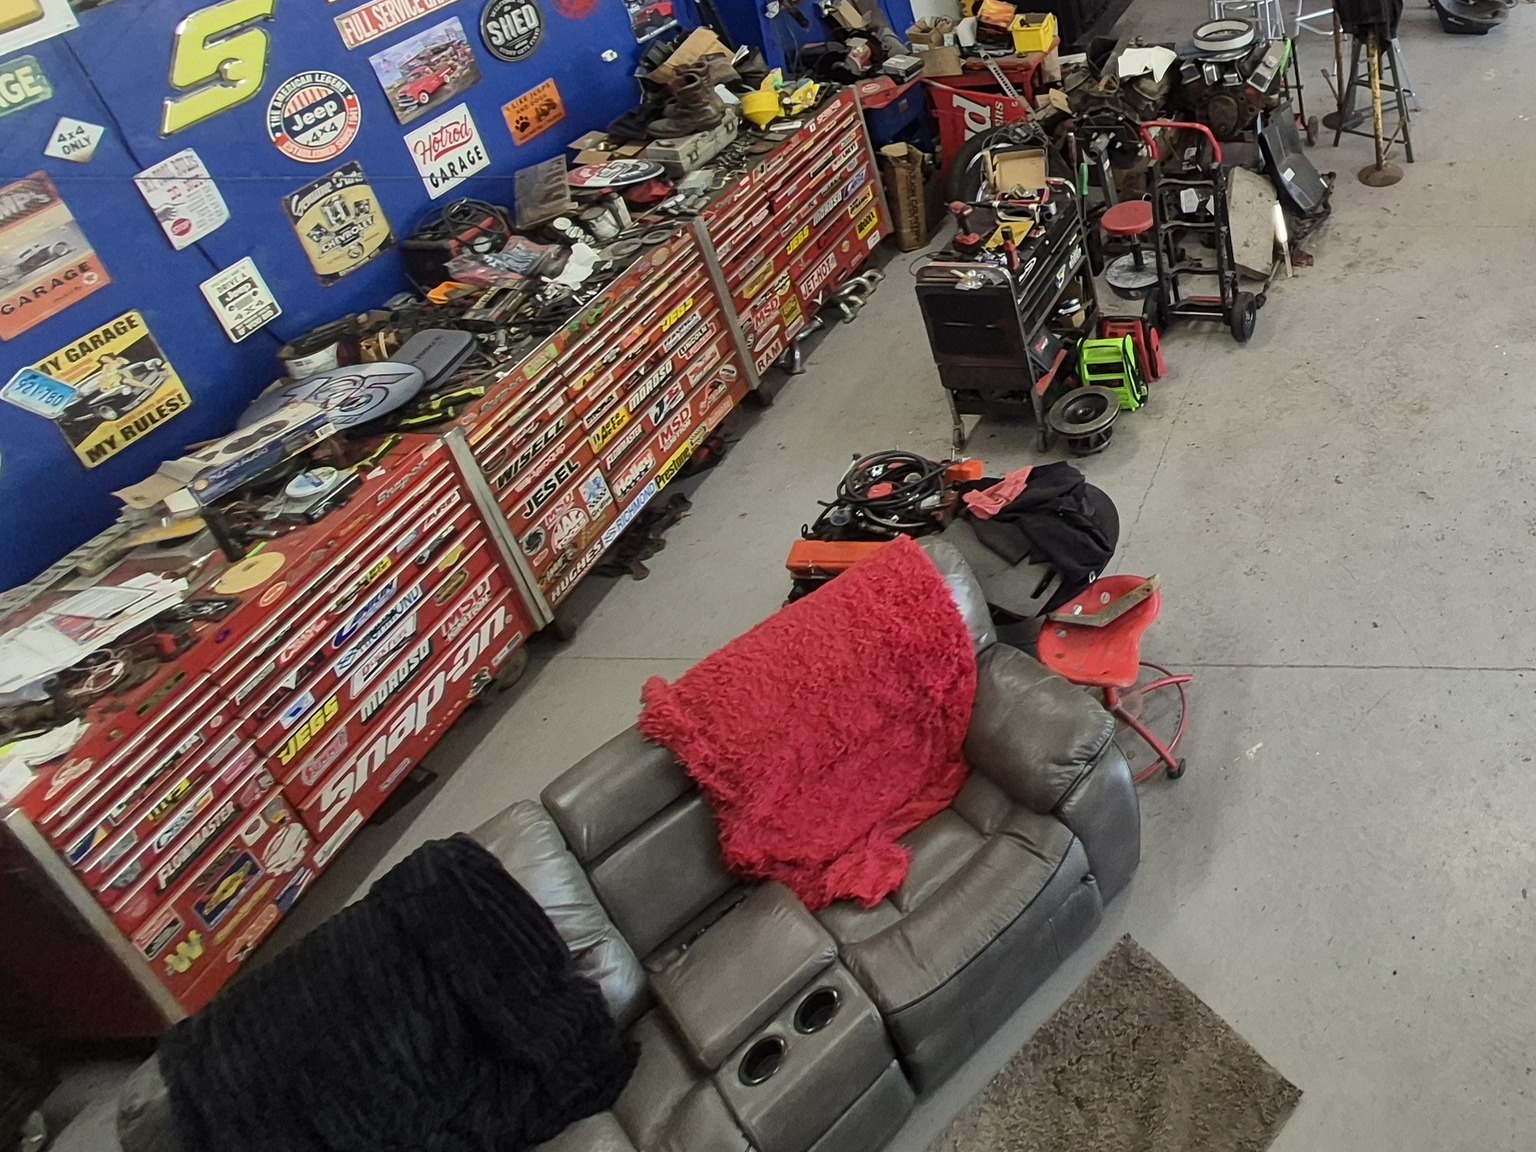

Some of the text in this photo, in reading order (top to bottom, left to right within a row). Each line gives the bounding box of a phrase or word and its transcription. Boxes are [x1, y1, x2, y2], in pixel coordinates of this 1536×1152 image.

[343, 10, 378, 45] FULL
[486, 3, 539, 46] SHED
[0, 65, 44, 107] GE
[270, 73, 347, 128] THE AMERICAN LEGEND
[528, 82, 551, 99] JEEPS
[291, 100, 338, 132] Jeep
[62, 135, 92, 156] ONLY
[414, 113, 473, 165] Hotrod
[428, 145, 484, 189] GARAGE
[321, 215, 375, 254] CHEVROLET
[0, 261, 92, 316] GARAGE
[802, 258, 832, 298] JET-HOT
[753, 295, 780, 330] MSD
[38, 314, 140, 376] MY GARAGE
[679, 323, 709, 357] LINCOLN
[756, 341, 781, 372] RAM
[628, 359, 674, 412] MOROSO
[85, 392, 187, 464] MY RULES!
[599, 415, 626, 443] Meter
[601, 412, 620, 431] Auto
[659, 405, 691, 444] MSD
[522, 458, 581, 519] JESEL
[613, 451, 654, 495] Holley
[655, 445, 691, 490] Prestone
[616, 481, 657, 529] RICHMOND
[552, 510, 583, 545] MAC
[551, 538, 603, 602] HUGHES
[441, 577, 490, 637] MSD
[360, 638, 431, 723] MOROSO
[277, 694, 340, 766] JEGS
[155, 800, 237, 891] FLOWMASTER
